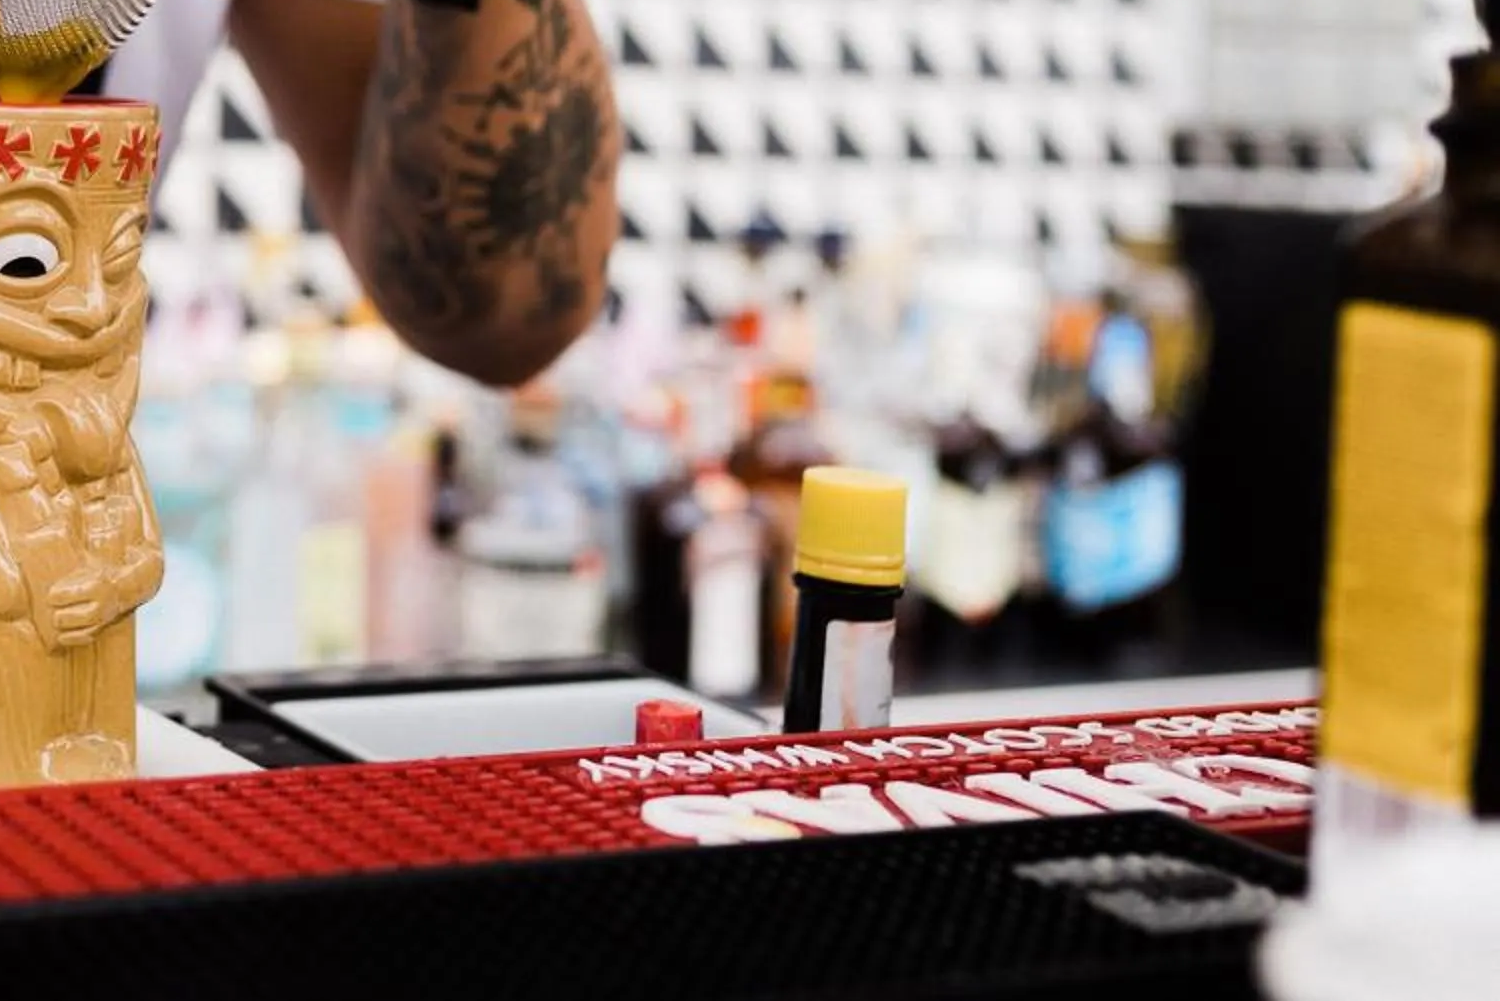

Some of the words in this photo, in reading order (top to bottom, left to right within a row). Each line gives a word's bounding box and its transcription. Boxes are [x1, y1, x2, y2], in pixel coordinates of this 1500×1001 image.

[843, 721, 1135, 761] SCOTCH
[578, 743, 850, 784] WHISKY
[640, 753, 1317, 847] CHIVAS
